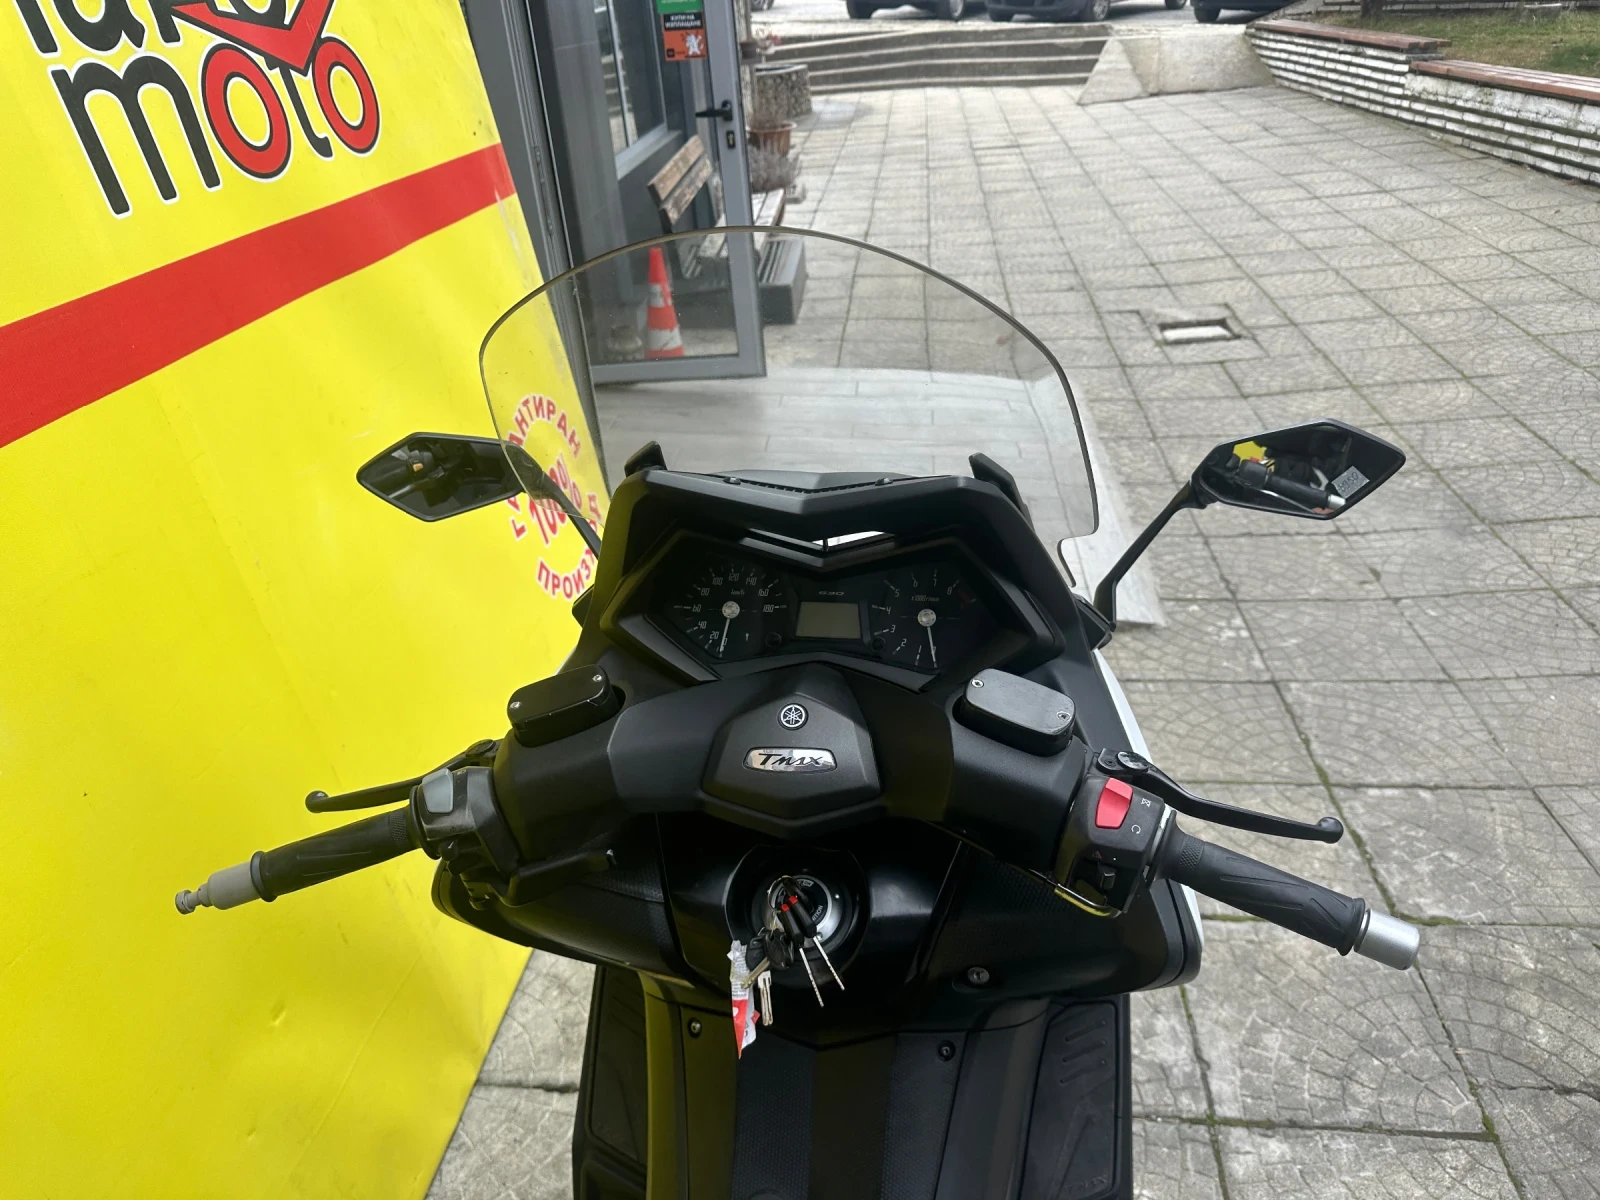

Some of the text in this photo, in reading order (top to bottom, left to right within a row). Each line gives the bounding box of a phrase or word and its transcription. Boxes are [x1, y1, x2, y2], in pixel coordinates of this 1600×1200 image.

[712, 577, 724, 586] 100
[728, 573, 739, 581] 120
[745, 577, 757, 586] 140
[700, 587, 710, 596] 80
[758, 588, 770, 597] 160
[894, 588, 900, 598] 5
[946, 586, 953, 595] 8
[692, 604, 702, 613] 60
[763, 604, 774, 613] 180
[885, 606, 891, 614] 4
[698, 620, 707, 629] 40
[890, 624, 896, 633] 3
[709, 631, 720, 639] 20
[900, 638, 907, 647] 2
